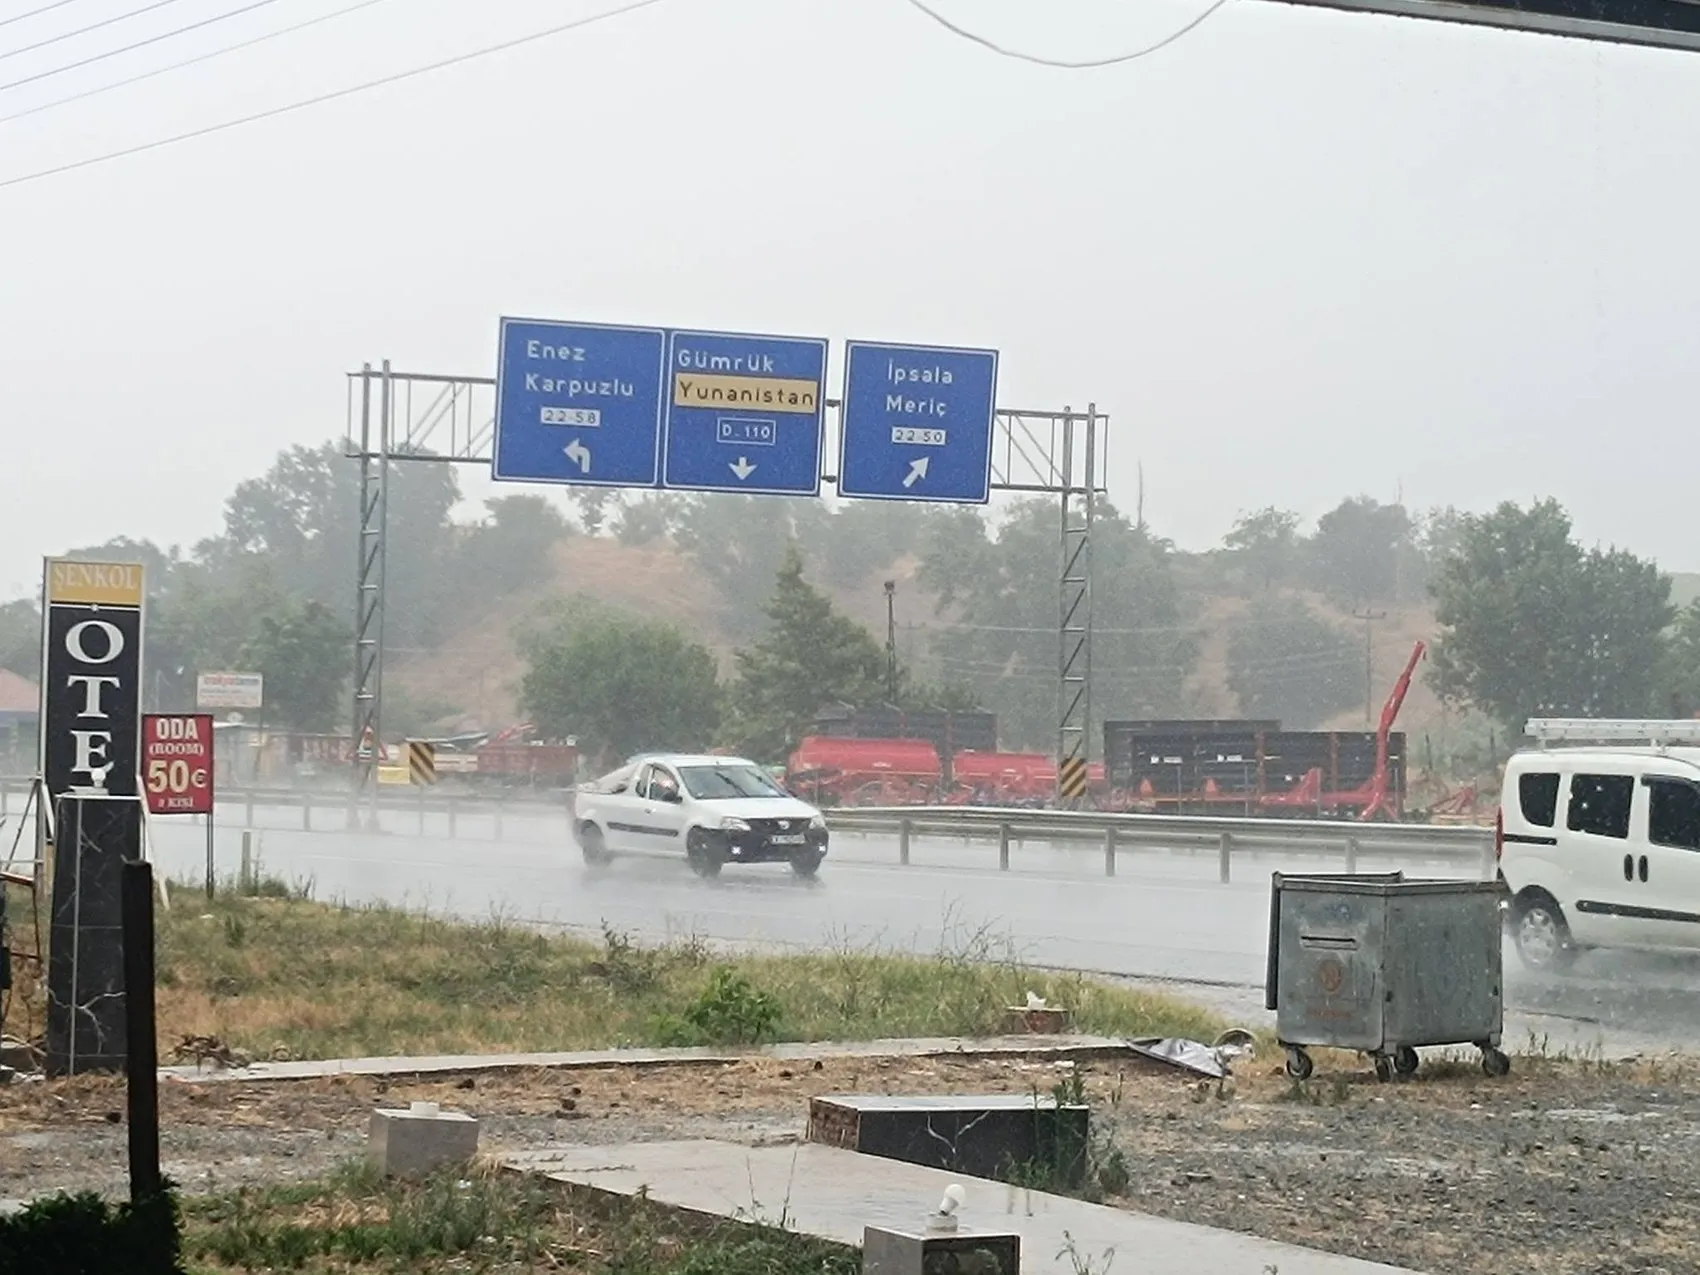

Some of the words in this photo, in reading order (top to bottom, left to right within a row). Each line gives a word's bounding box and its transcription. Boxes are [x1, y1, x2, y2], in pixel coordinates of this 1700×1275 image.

[526, 339, 586, 362] Enez
[677, 348, 774, 373] Gümrük
[887, 358, 953, 385] İpsala
[524, 373, 635, 398] Karpuzlu
[679, 378, 815, 407] Yunanistan
[885, 394, 948, 418] Meriç
[65, 620, 125, 796] OTE
[155, 717, 199, 740] ODA
